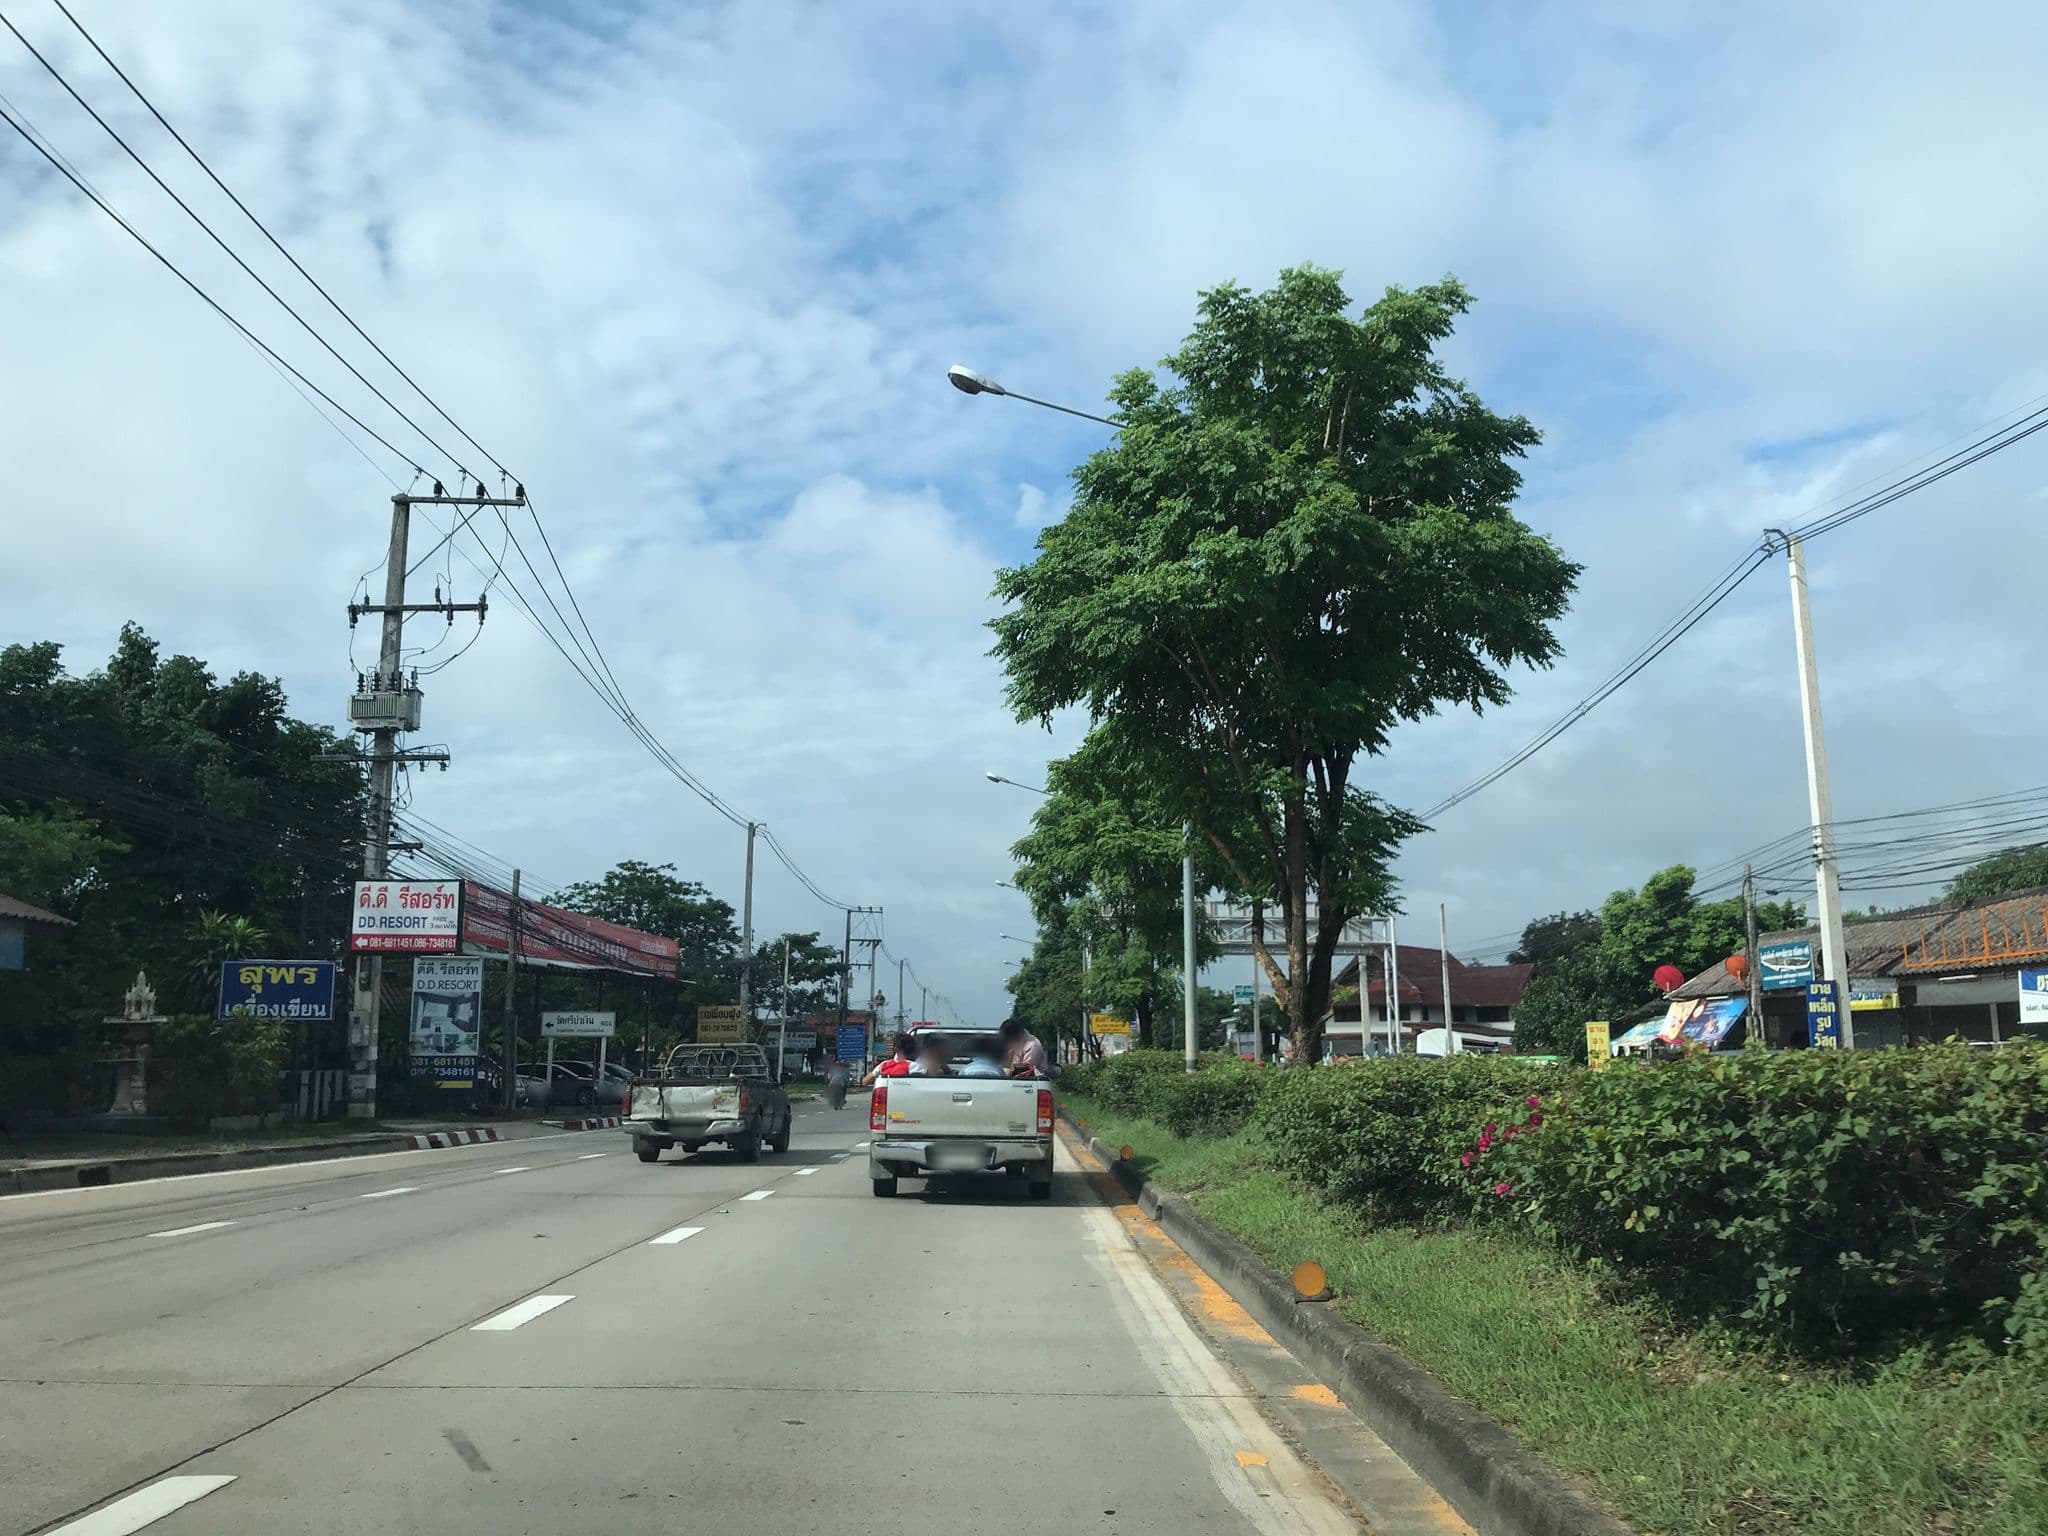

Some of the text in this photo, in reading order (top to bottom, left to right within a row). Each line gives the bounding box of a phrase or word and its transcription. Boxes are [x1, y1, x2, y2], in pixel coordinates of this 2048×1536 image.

[360, 885, 389, 909] ดี.ดี
[399, 884, 455, 909] รีสอร์ท
[358, 916, 428, 929] DD.RESORT
[238, 965, 319, 994] สุพร
[417, 979, 479, 990] D.D.RESORT
[1810, 983, 1832, 995] ขาย
[1808, 996, 1836, 1013] เหล็ก
[1816, 1015, 1832, 1032] รูป
